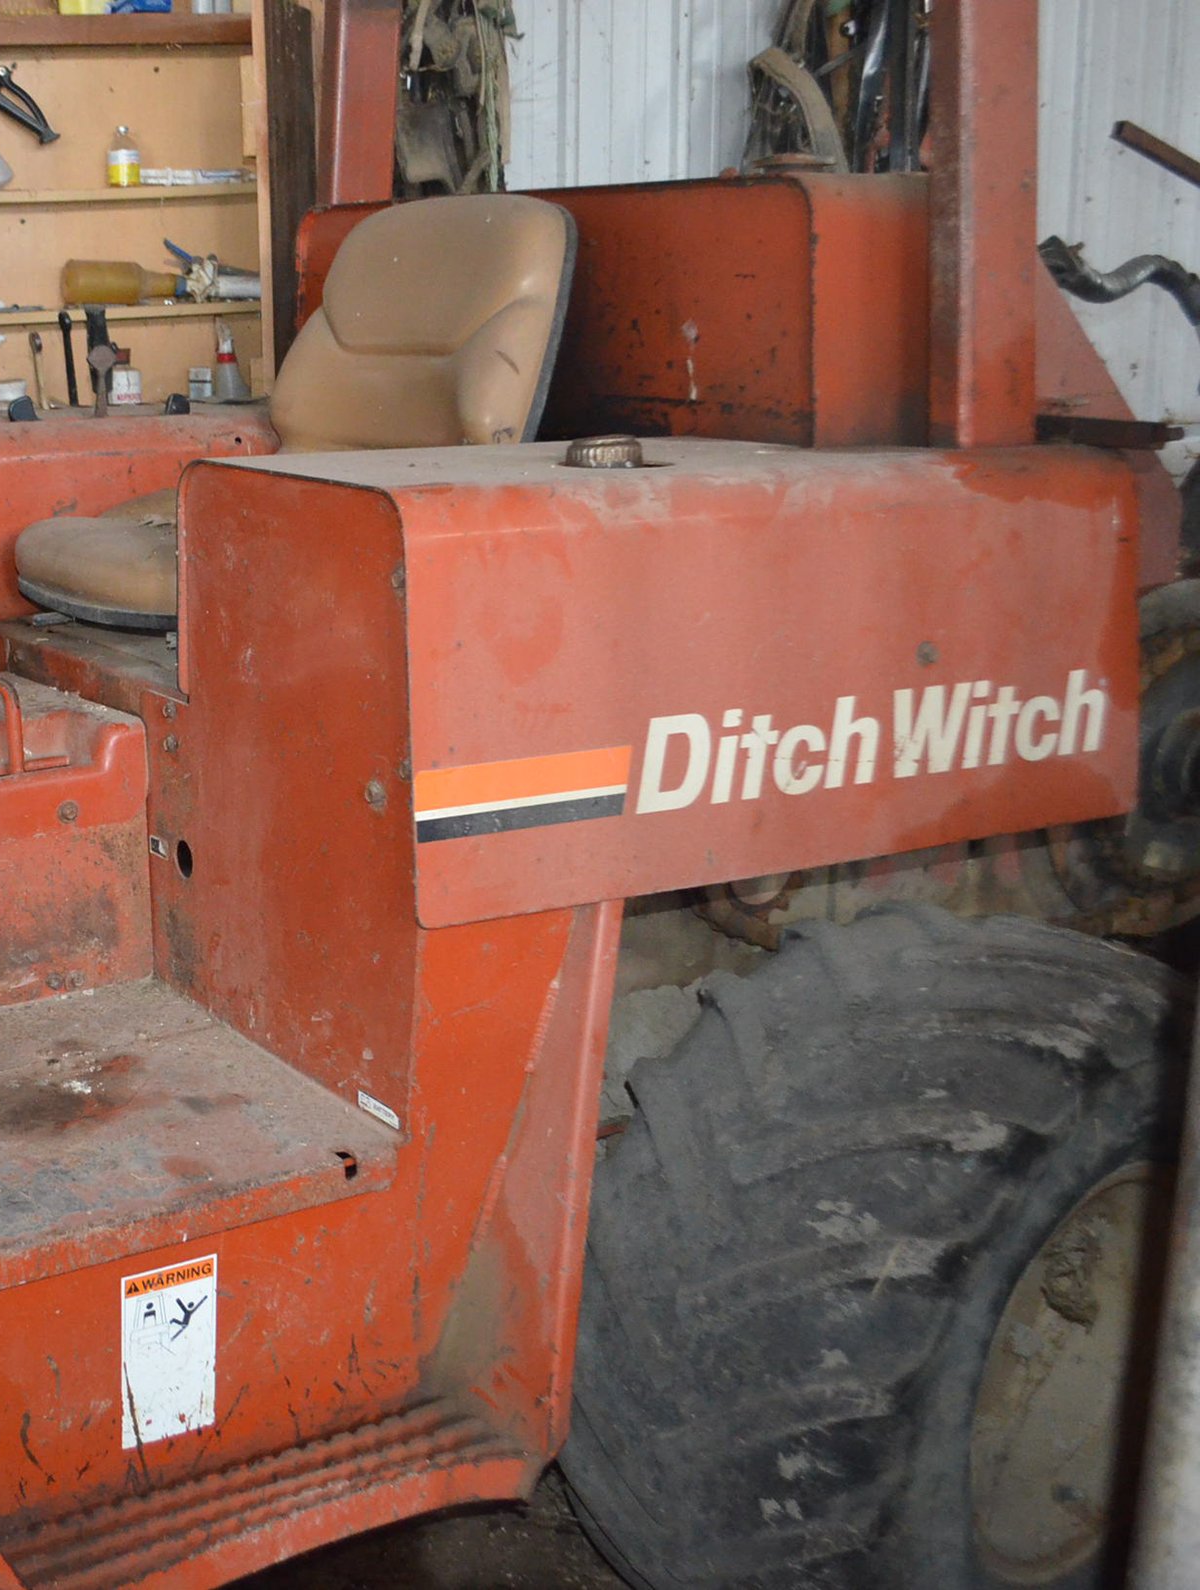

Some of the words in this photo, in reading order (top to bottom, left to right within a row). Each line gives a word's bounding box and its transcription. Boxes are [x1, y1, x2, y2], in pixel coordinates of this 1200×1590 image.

[636, 695, 881, 815] Ditch
[893, 669, 1108, 779] Witch
[141, 1262, 212, 1292] WARNING
